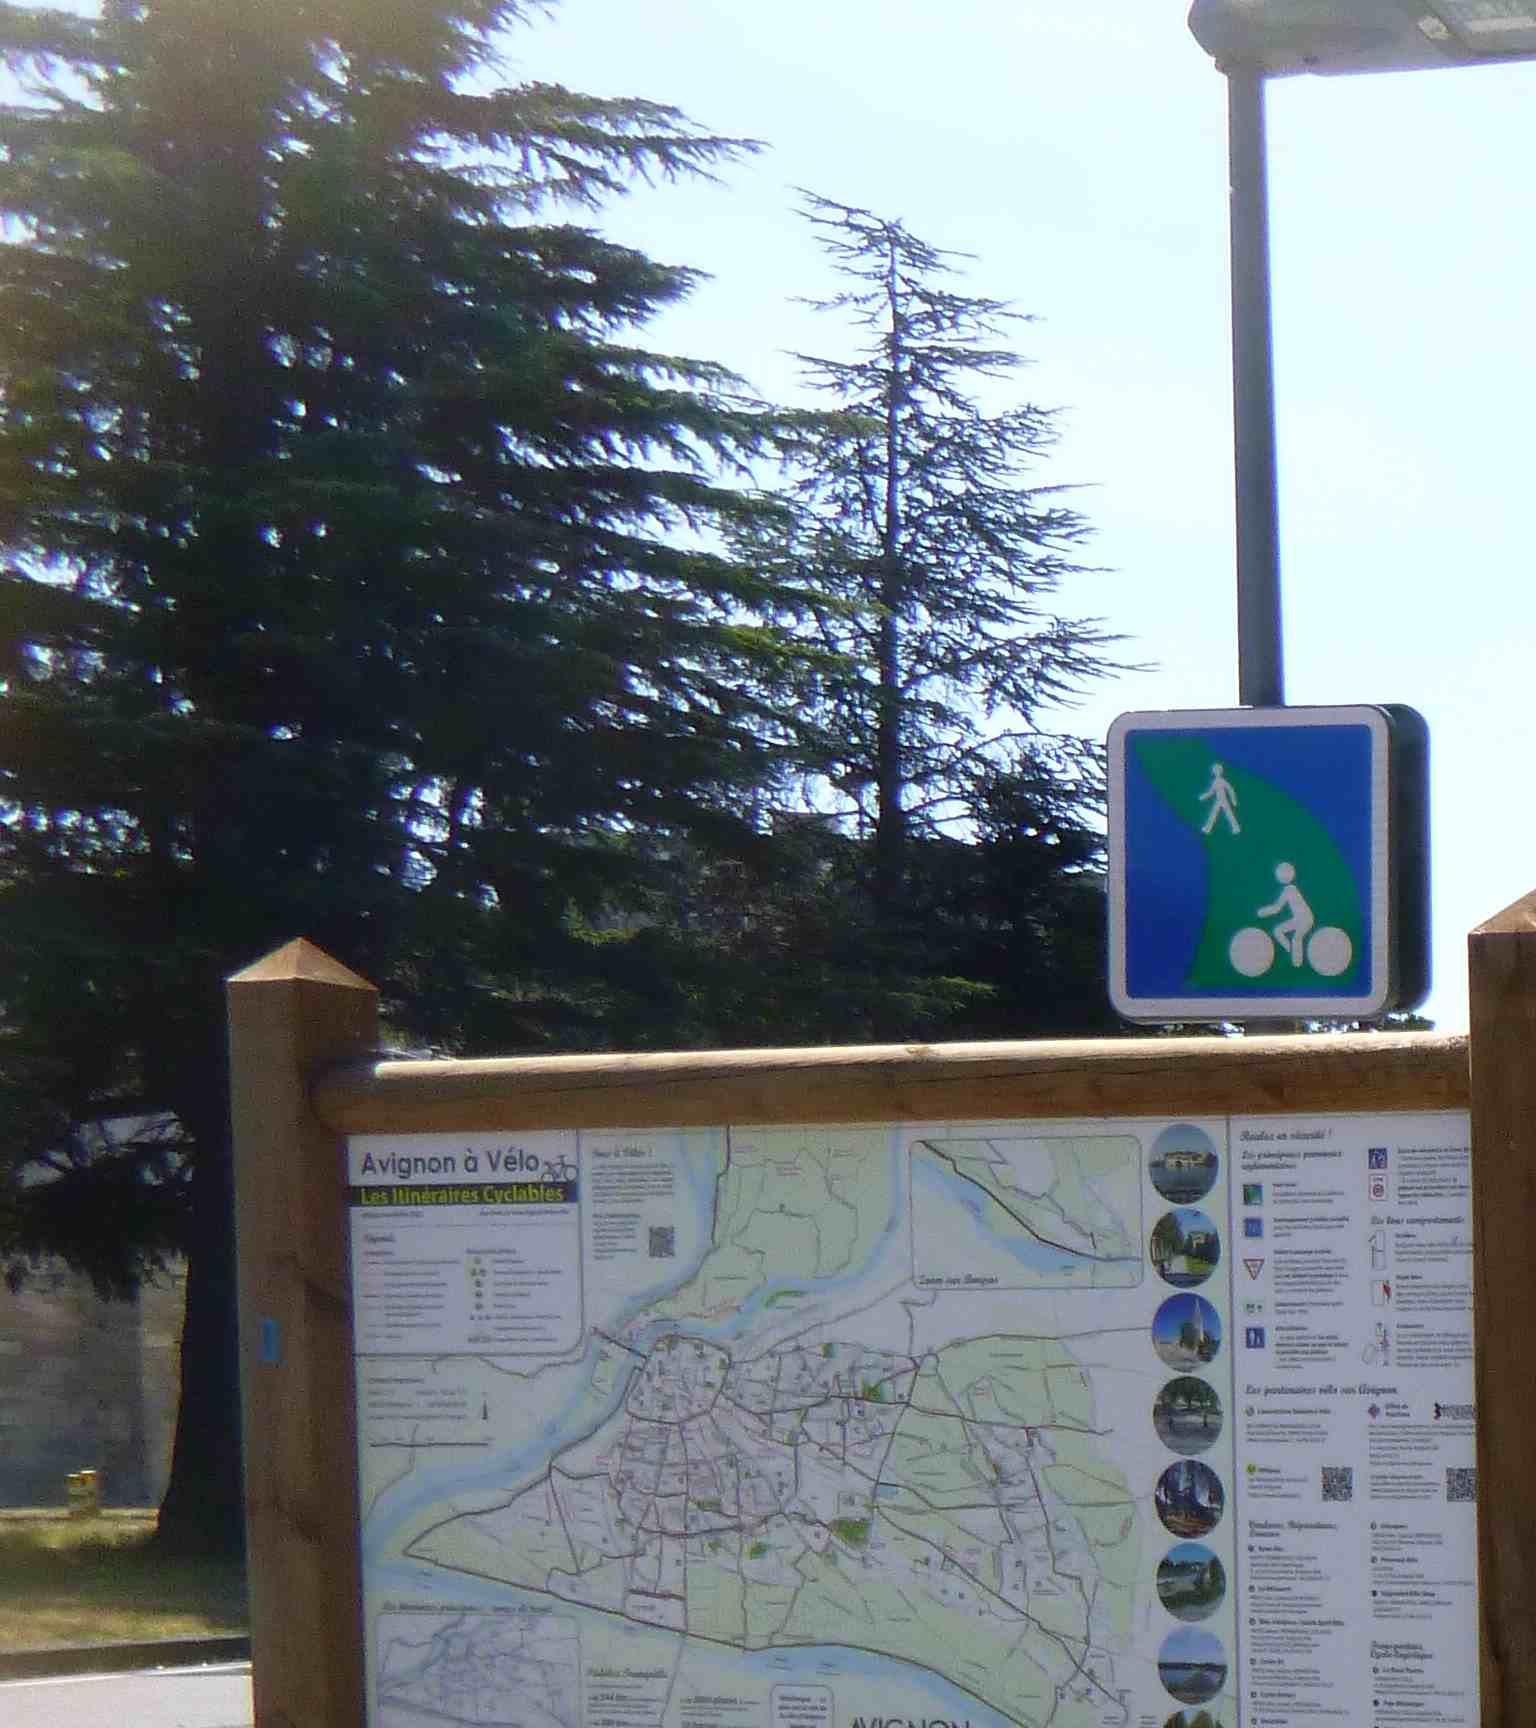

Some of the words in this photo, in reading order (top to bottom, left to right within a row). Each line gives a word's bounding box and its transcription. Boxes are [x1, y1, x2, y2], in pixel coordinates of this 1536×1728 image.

[361, 1152, 455, 1178] Avignon
[463, 1148, 479, 1173] à
[486, 1147, 540, 1172] Vélo
[361, 1187, 389, 1204] Les
[393, 1185, 479, 1203] Itinéraires
[483, 1183, 565, 1204] Cyclables
